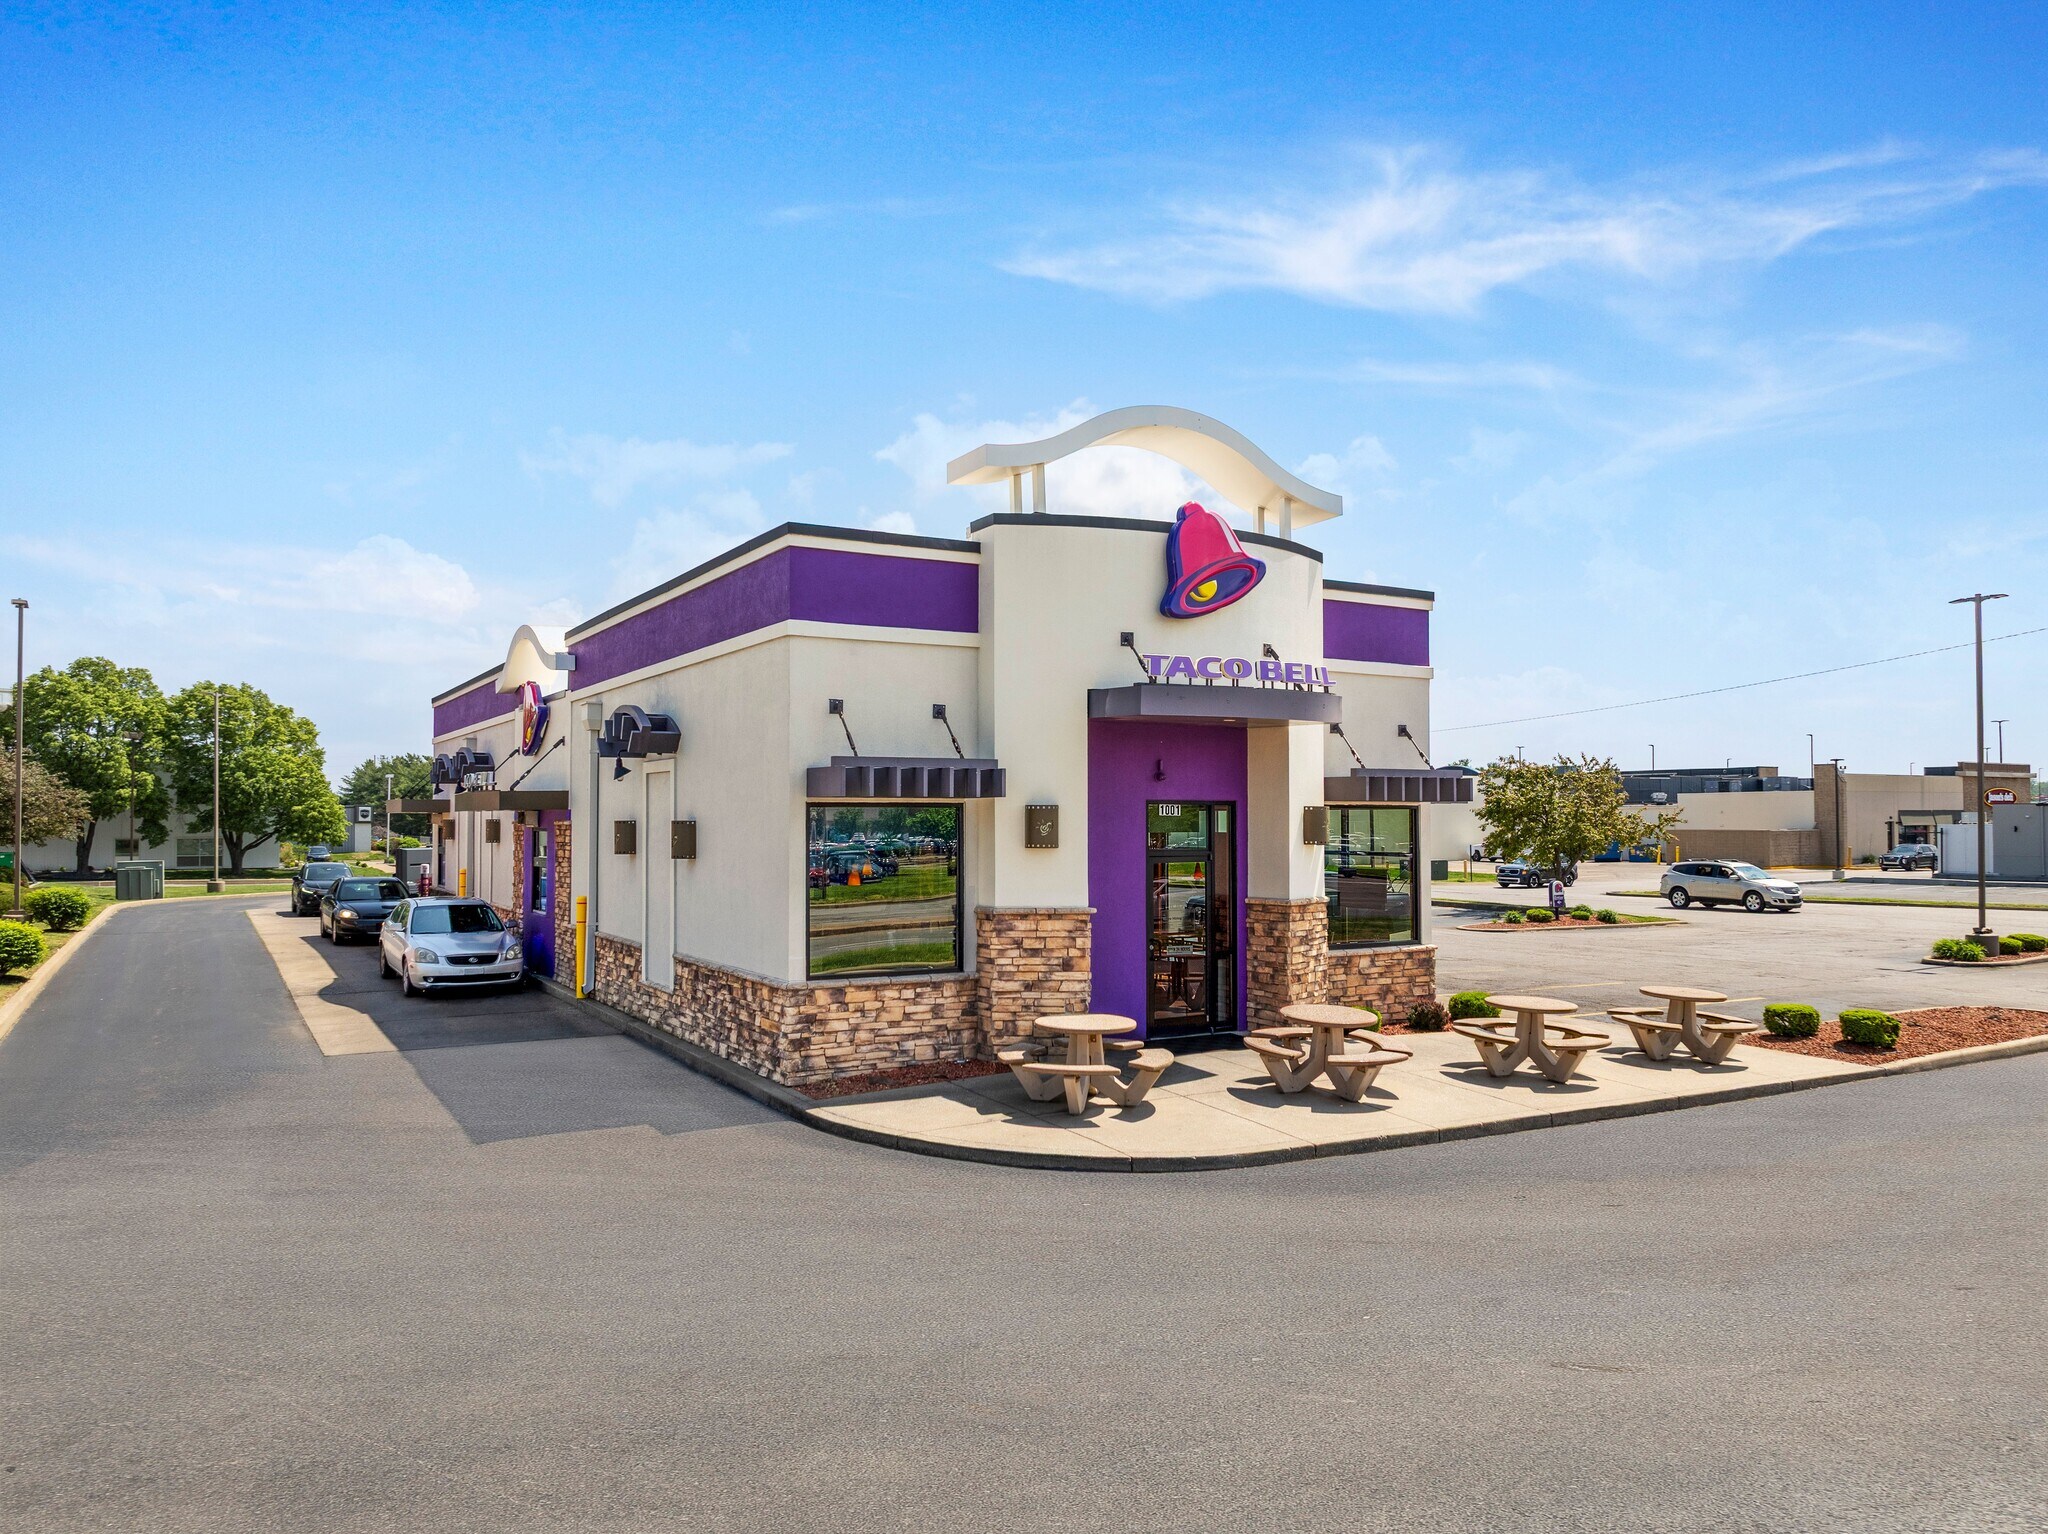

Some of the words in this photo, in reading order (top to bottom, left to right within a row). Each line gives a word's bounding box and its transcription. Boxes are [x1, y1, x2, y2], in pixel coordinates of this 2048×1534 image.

[1142, 654, 1252, 679] TACO
[1256, 660, 1337, 686] BELL
[1160, 805, 1180, 815] 1001
